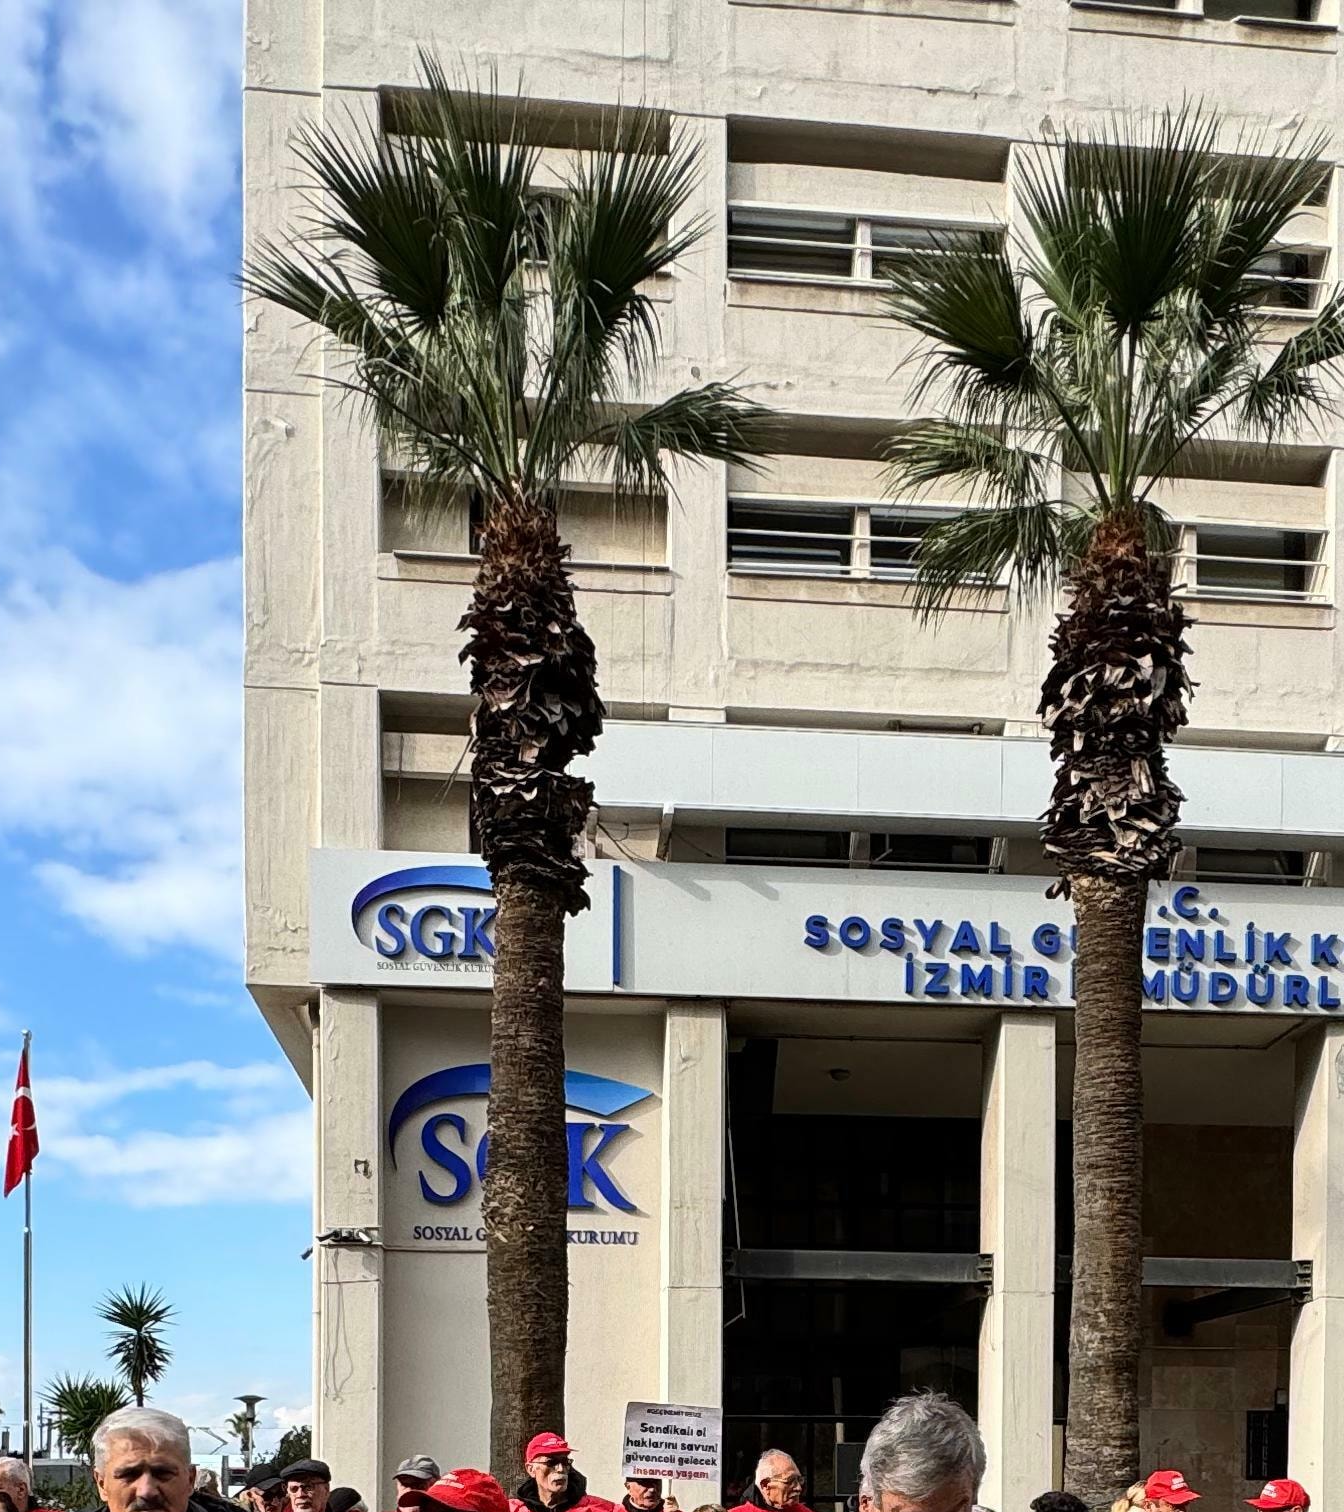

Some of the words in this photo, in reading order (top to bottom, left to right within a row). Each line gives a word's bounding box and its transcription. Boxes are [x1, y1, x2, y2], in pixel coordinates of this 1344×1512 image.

[1158, 886, 1219, 920] .C.
[375, 903, 498, 959] SGK
[804, 915, 1012, 957] SOSYAL
[1032, 922, 1293, 968] GENLİK
[464, 963, 496, 974] KURU
[904, 953, 1049, 999] İZMİR
[413, 1226, 473, 1241] SOSYAL
[640, 1422, 694, 1437] Sendikalı
[696, 1427, 707, 1437] ol
[626, 1436, 678, 1450] haklarını
[625, 1451, 676, 1464] güvenceli
[678, 1456, 718, 1466] gelecek
[676, 1470, 709, 1480] yaşam
